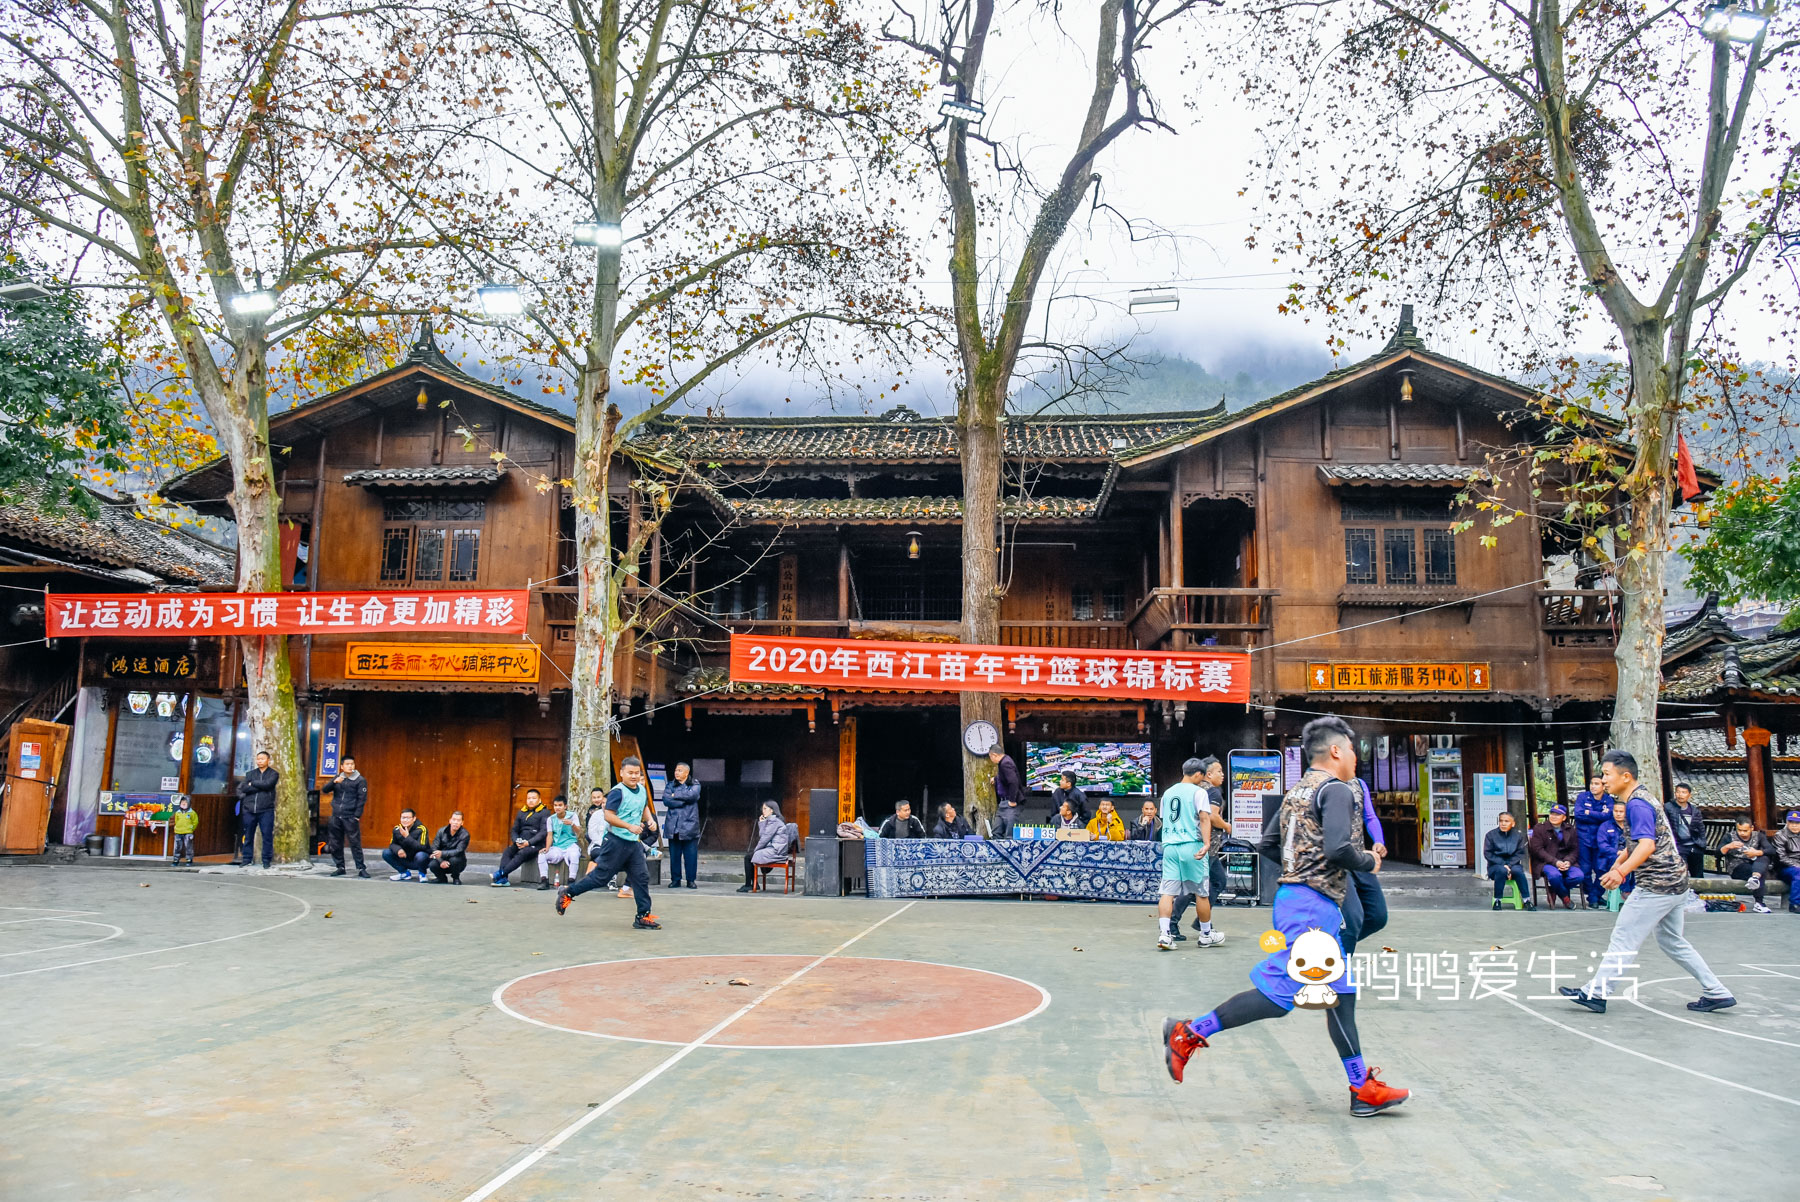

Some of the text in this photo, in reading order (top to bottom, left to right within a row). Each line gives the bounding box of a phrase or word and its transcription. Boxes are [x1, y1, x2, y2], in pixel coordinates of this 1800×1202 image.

[59, 596, 515, 630] 让运动成为习惯 让生命更加精彩
[111, 655, 191, 676] 鸿运酒店
[748, 646, 1233, 694] 2020年西江苗年节篮球锦标赛
[1337, 667, 1463, 686] 西江旅游服务中心
[324, 712, 339, 769] 今日有房
[1169, 796, 1182, 824] 9
[1022, 829, 1055, 839] 19 35
